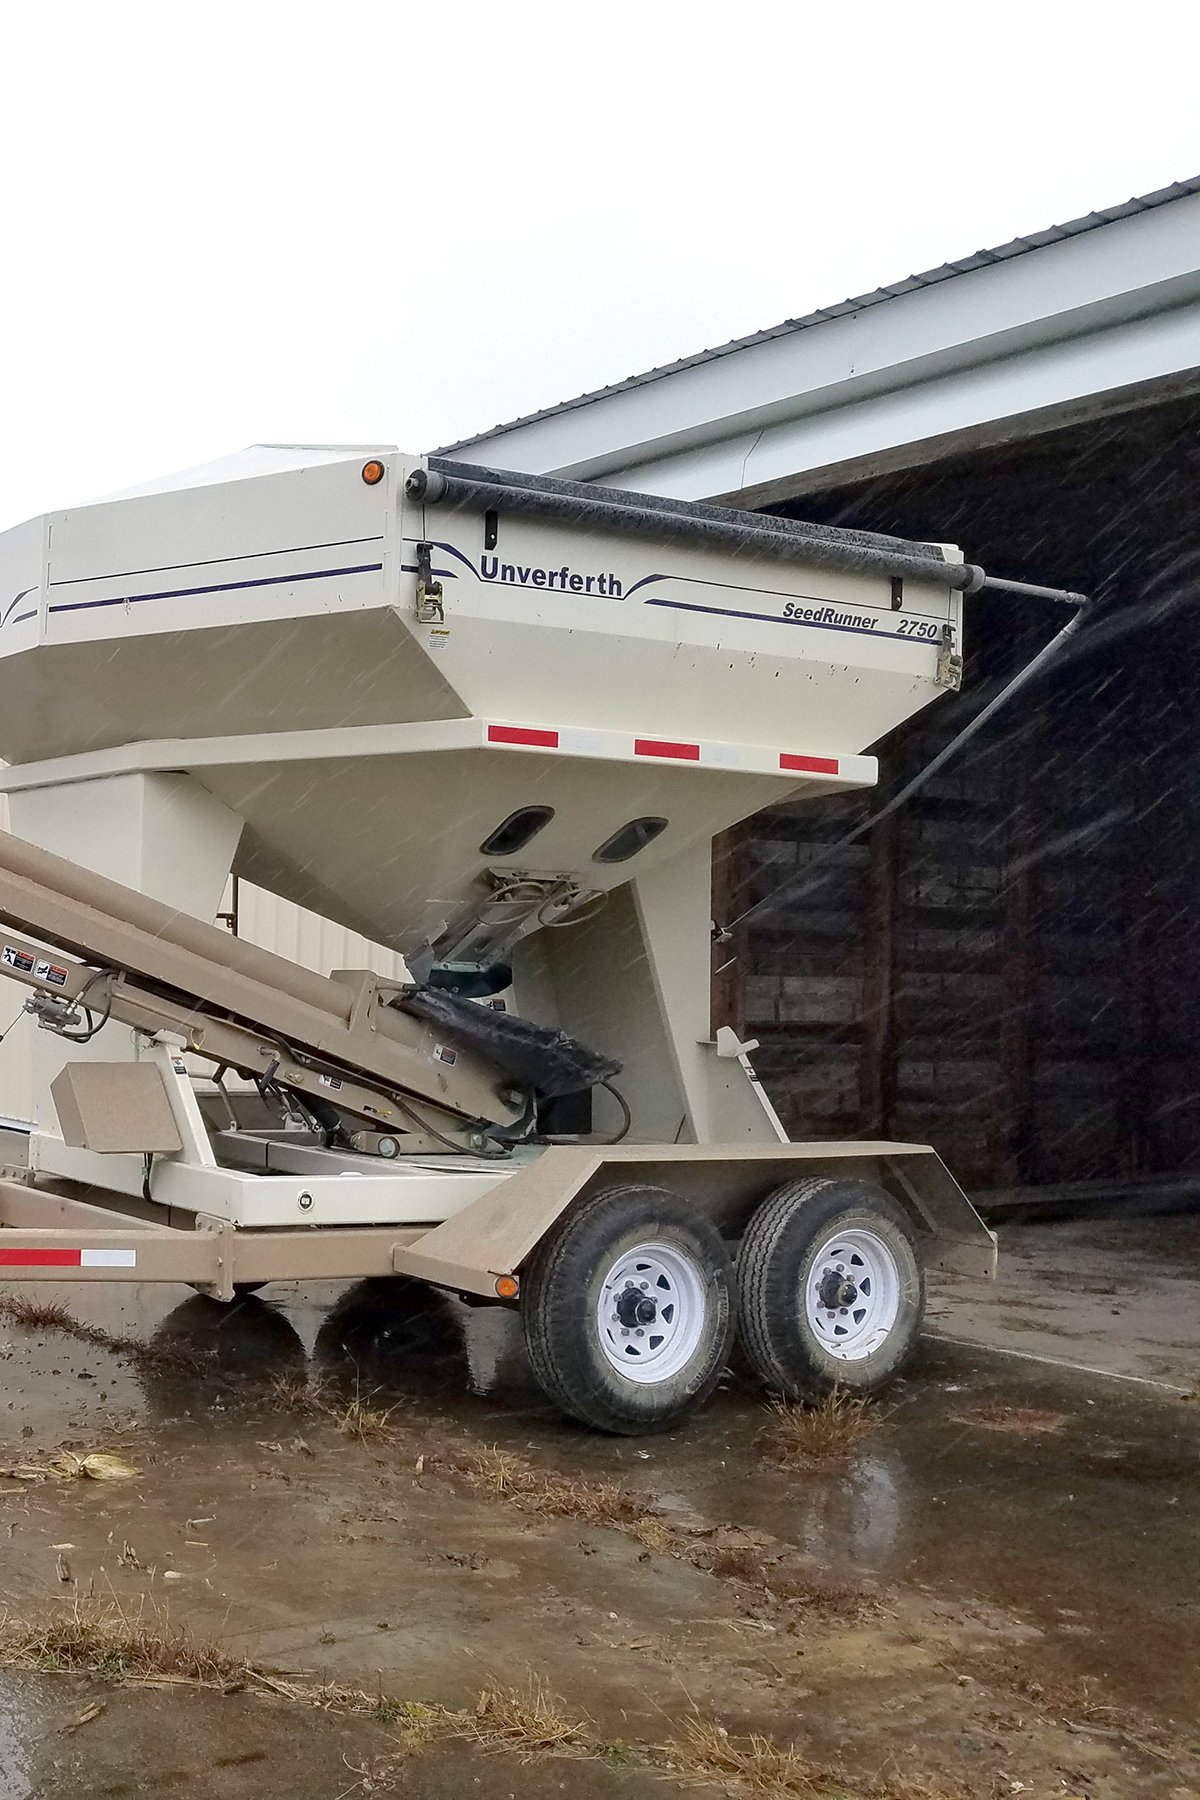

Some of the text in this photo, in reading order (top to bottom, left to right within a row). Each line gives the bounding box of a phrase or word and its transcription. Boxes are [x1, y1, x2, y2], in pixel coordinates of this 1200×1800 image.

[481, 555, 622, 596] Unverferth
[783, 602, 938, 639] SeedRunner 2750
